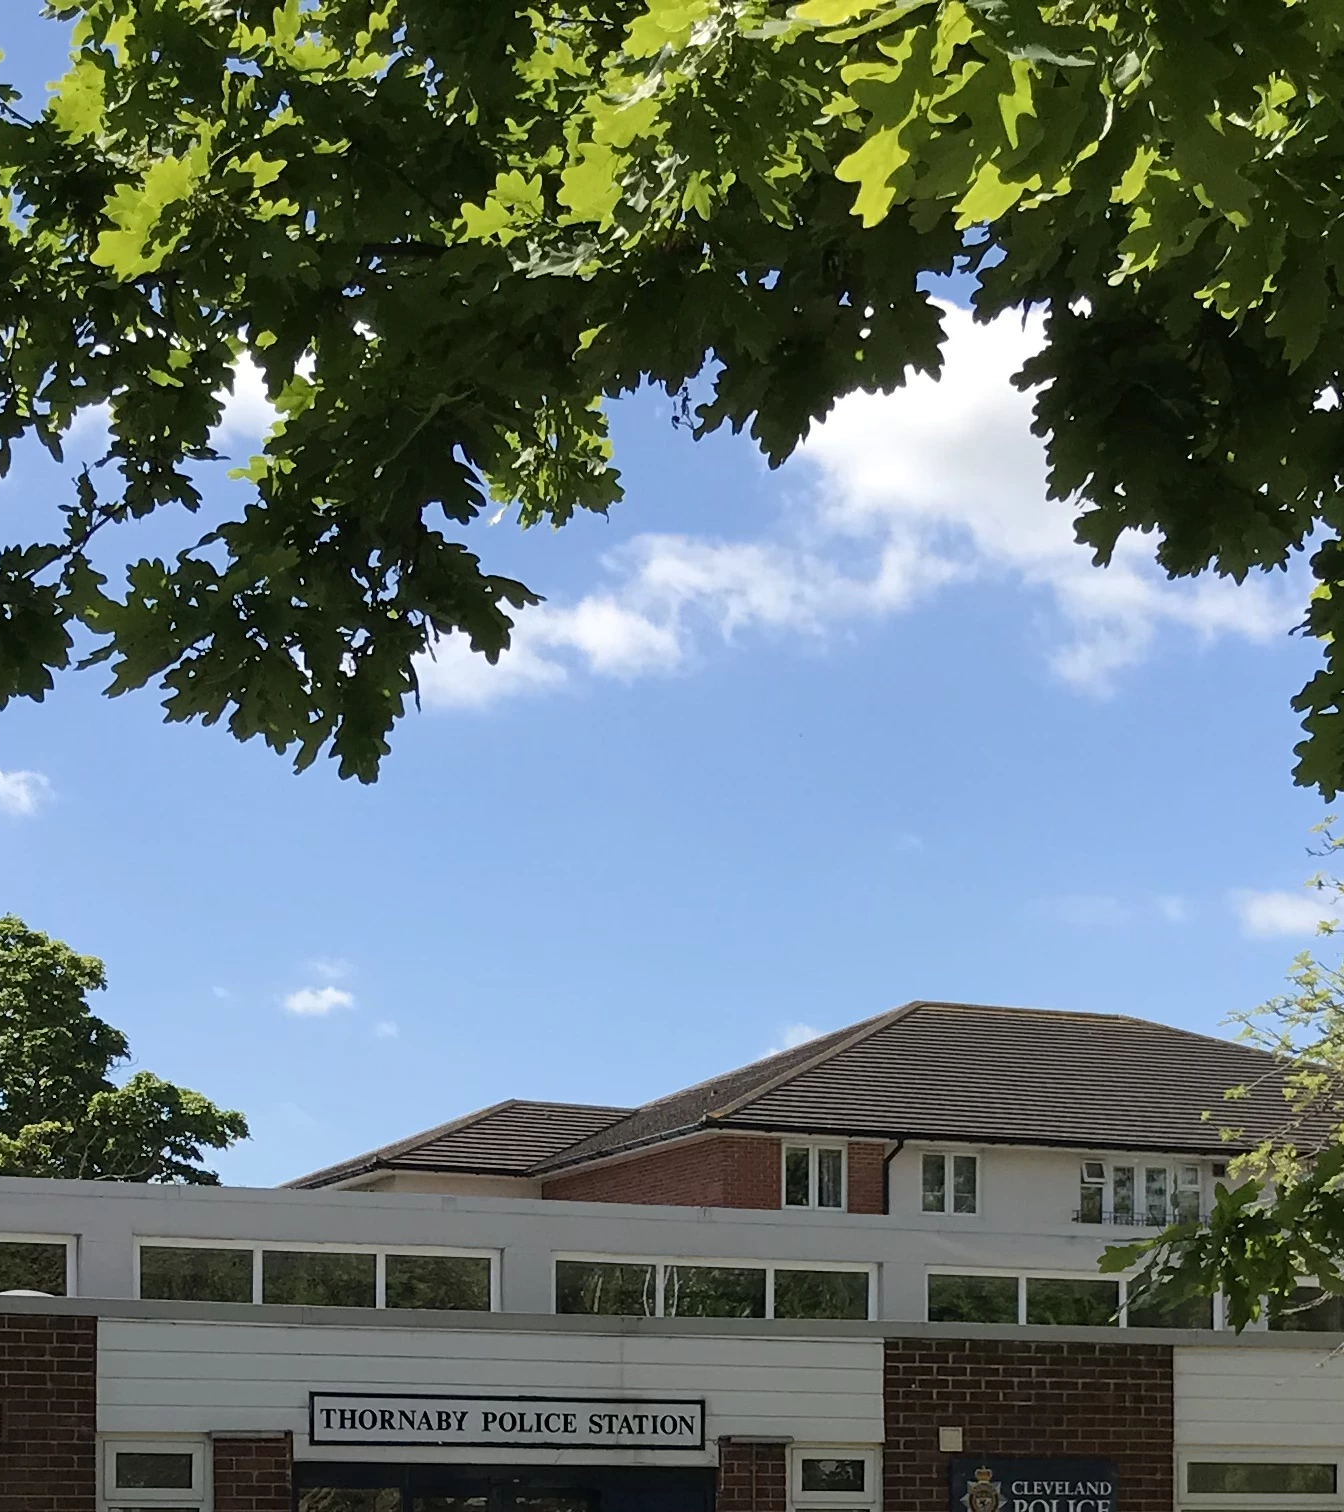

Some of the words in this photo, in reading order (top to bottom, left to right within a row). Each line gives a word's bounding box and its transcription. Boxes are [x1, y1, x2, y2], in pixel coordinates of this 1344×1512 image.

[319, 1407, 469, 1431] THORNABY
[481, 1411, 578, 1434] POLICE
[588, 1413, 696, 1436] STATION
[1011, 1480, 1112, 1495] CLEVELAND
